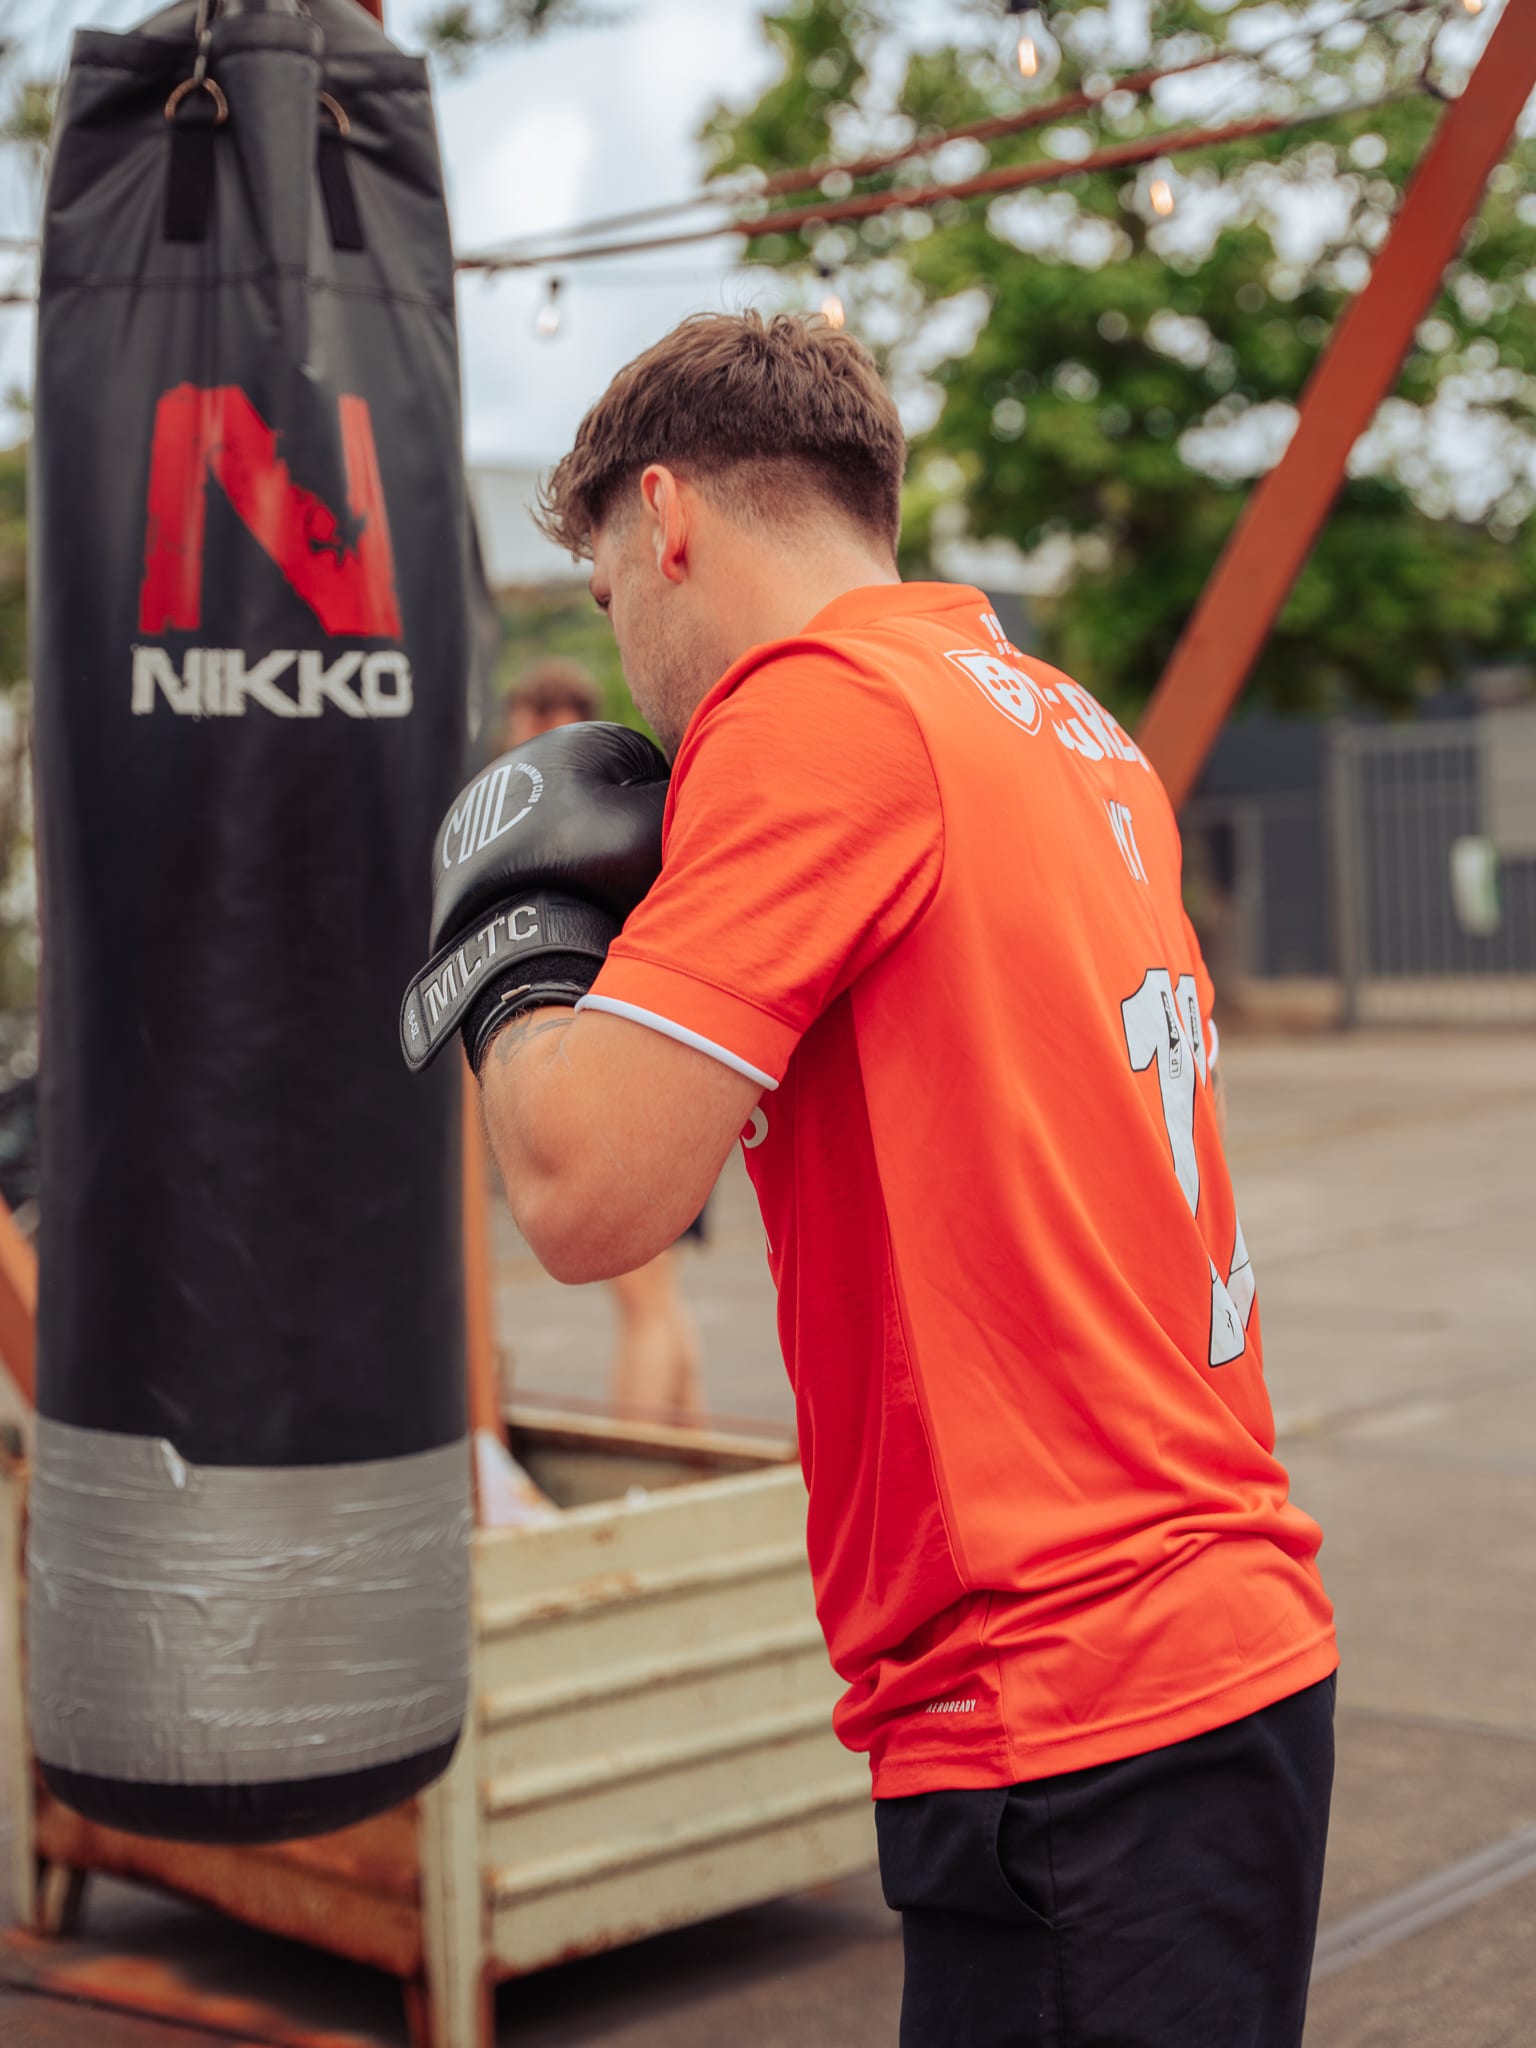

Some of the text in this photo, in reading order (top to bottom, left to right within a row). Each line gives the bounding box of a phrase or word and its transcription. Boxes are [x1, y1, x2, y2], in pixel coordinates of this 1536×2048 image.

[131, 646, 413, 719] NIKKO
[527, 784, 544, 803] CLUB
[424, 905, 539, 1025] MLTC
[925, 1698, 977, 1713] AEROREADY
